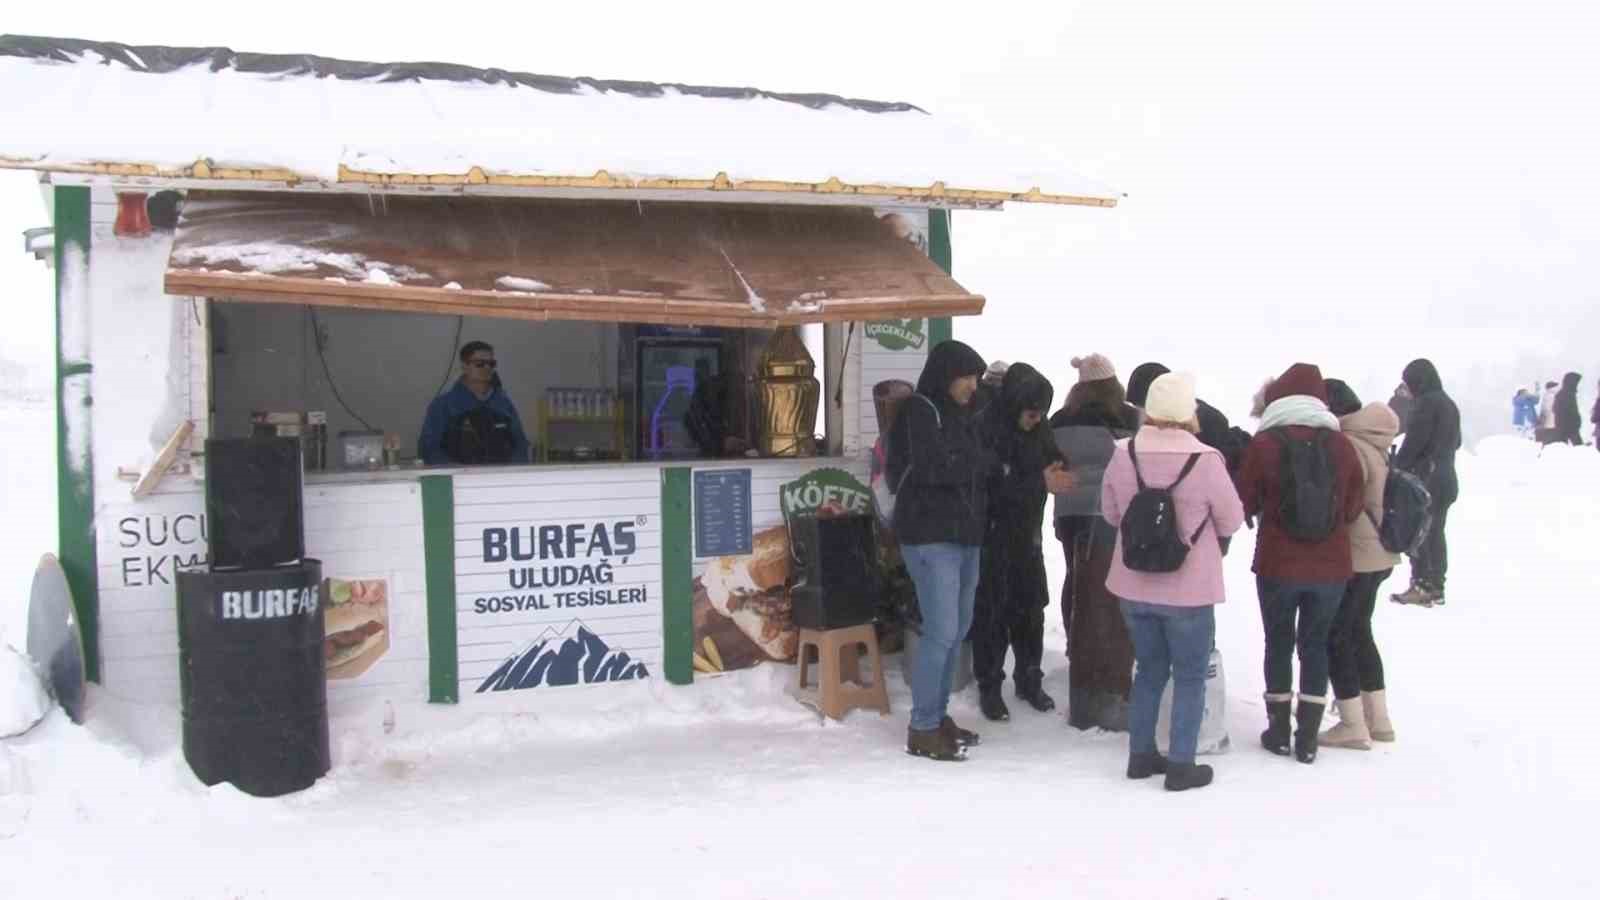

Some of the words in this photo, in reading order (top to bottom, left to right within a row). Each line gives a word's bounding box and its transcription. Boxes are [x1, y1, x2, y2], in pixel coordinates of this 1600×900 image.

[784, 481, 871, 515] KÖFTE
[509, 558, 613, 589] ULUDAĞ
[474, 594, 549, 614] SOSYAL
[553, 584, 647, 609] TESİSLERİ
